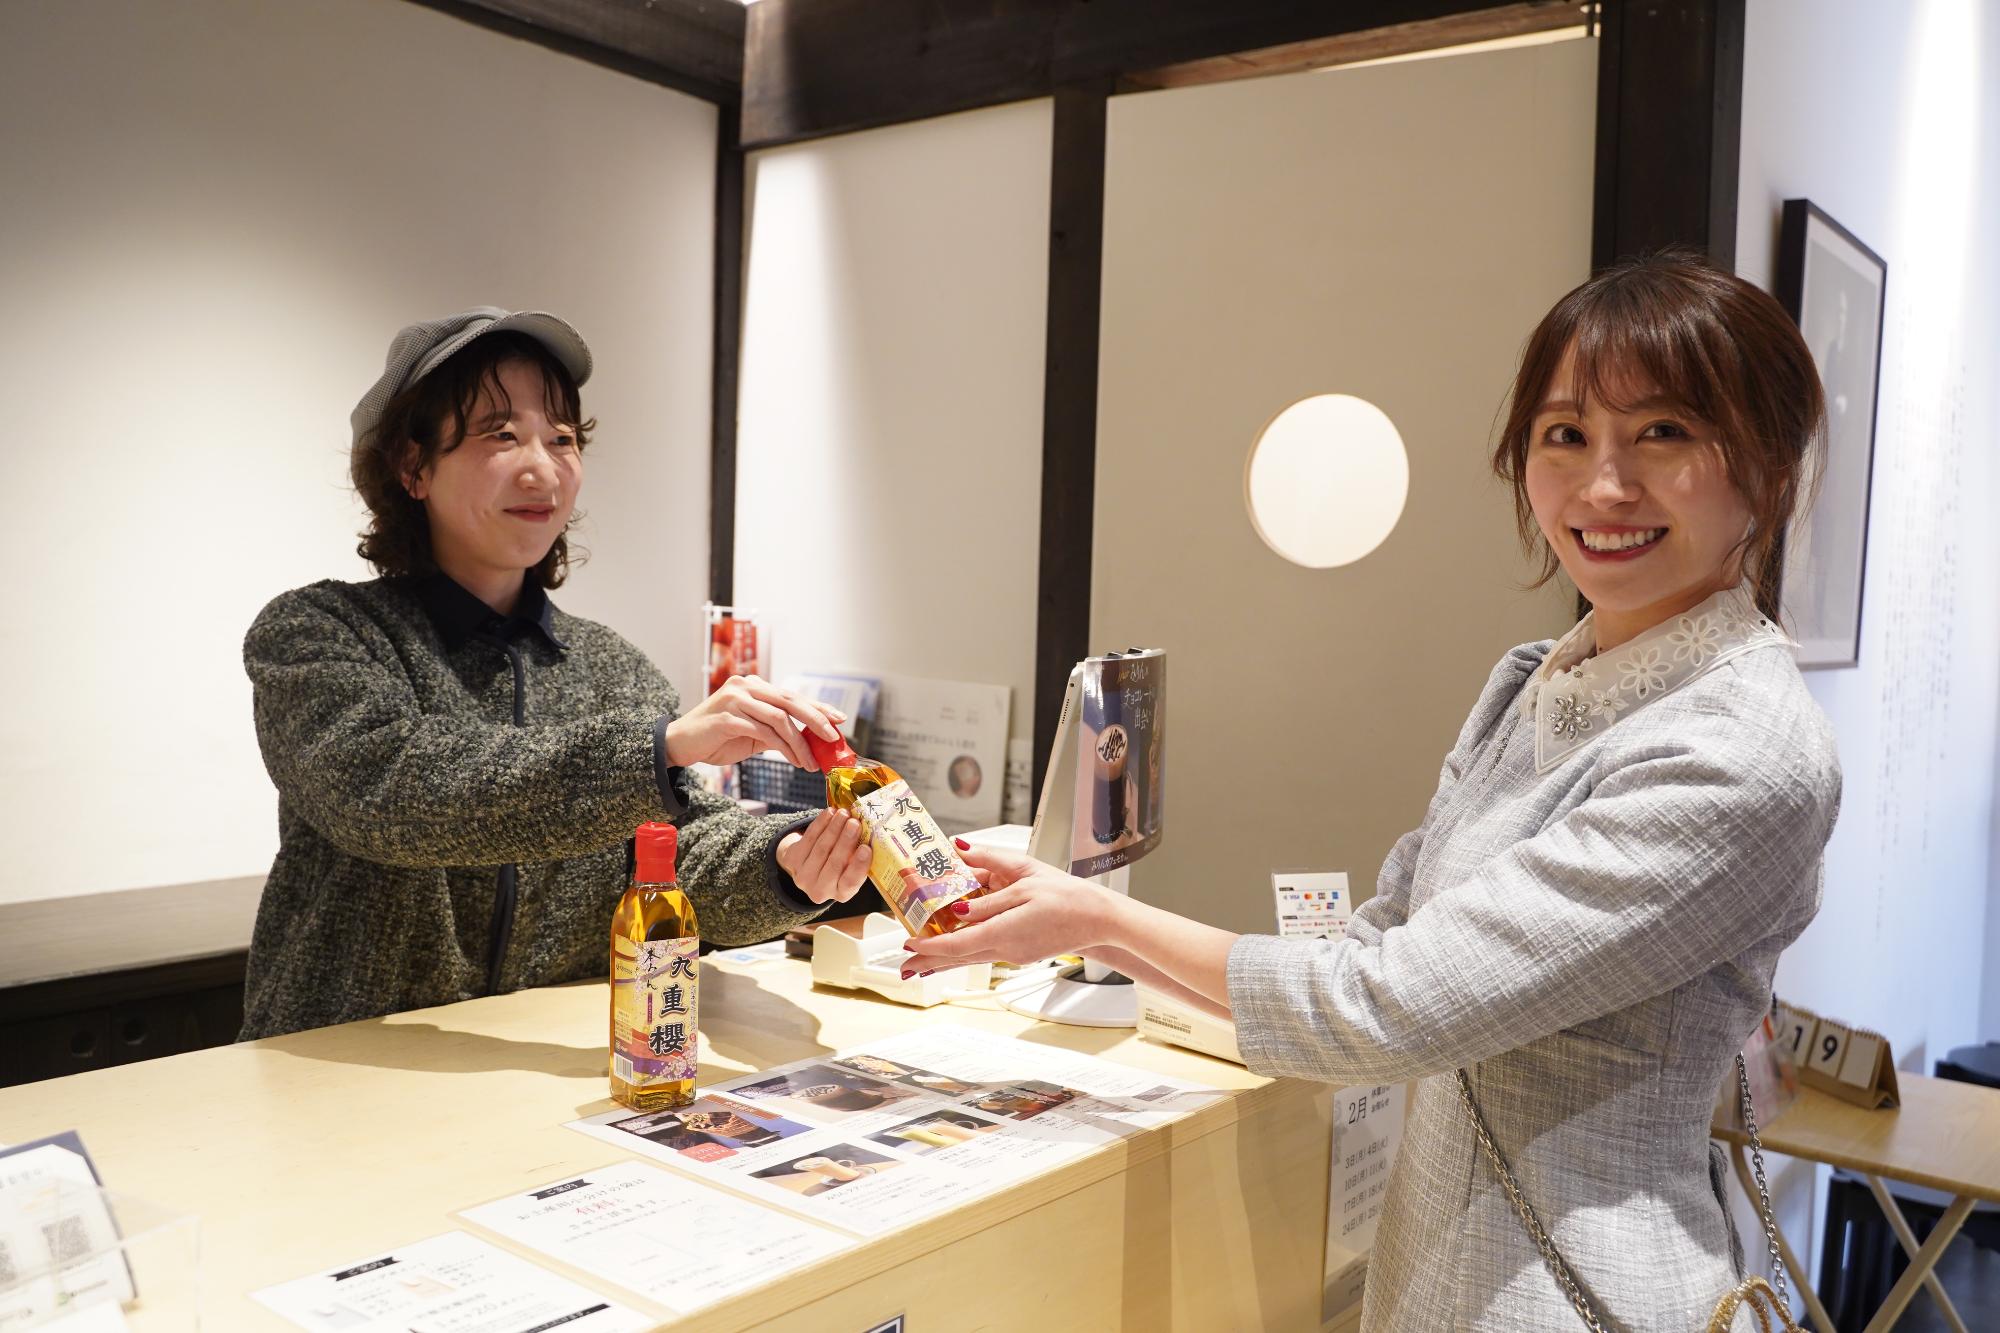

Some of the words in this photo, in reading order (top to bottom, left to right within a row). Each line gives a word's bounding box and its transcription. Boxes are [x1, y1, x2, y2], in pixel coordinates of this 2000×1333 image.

[895, 797, 952, 879] 九重櫻
[649, 956, 696, 1055] 九重櫻
[1349, 1096, 1366, 1124] 2月
